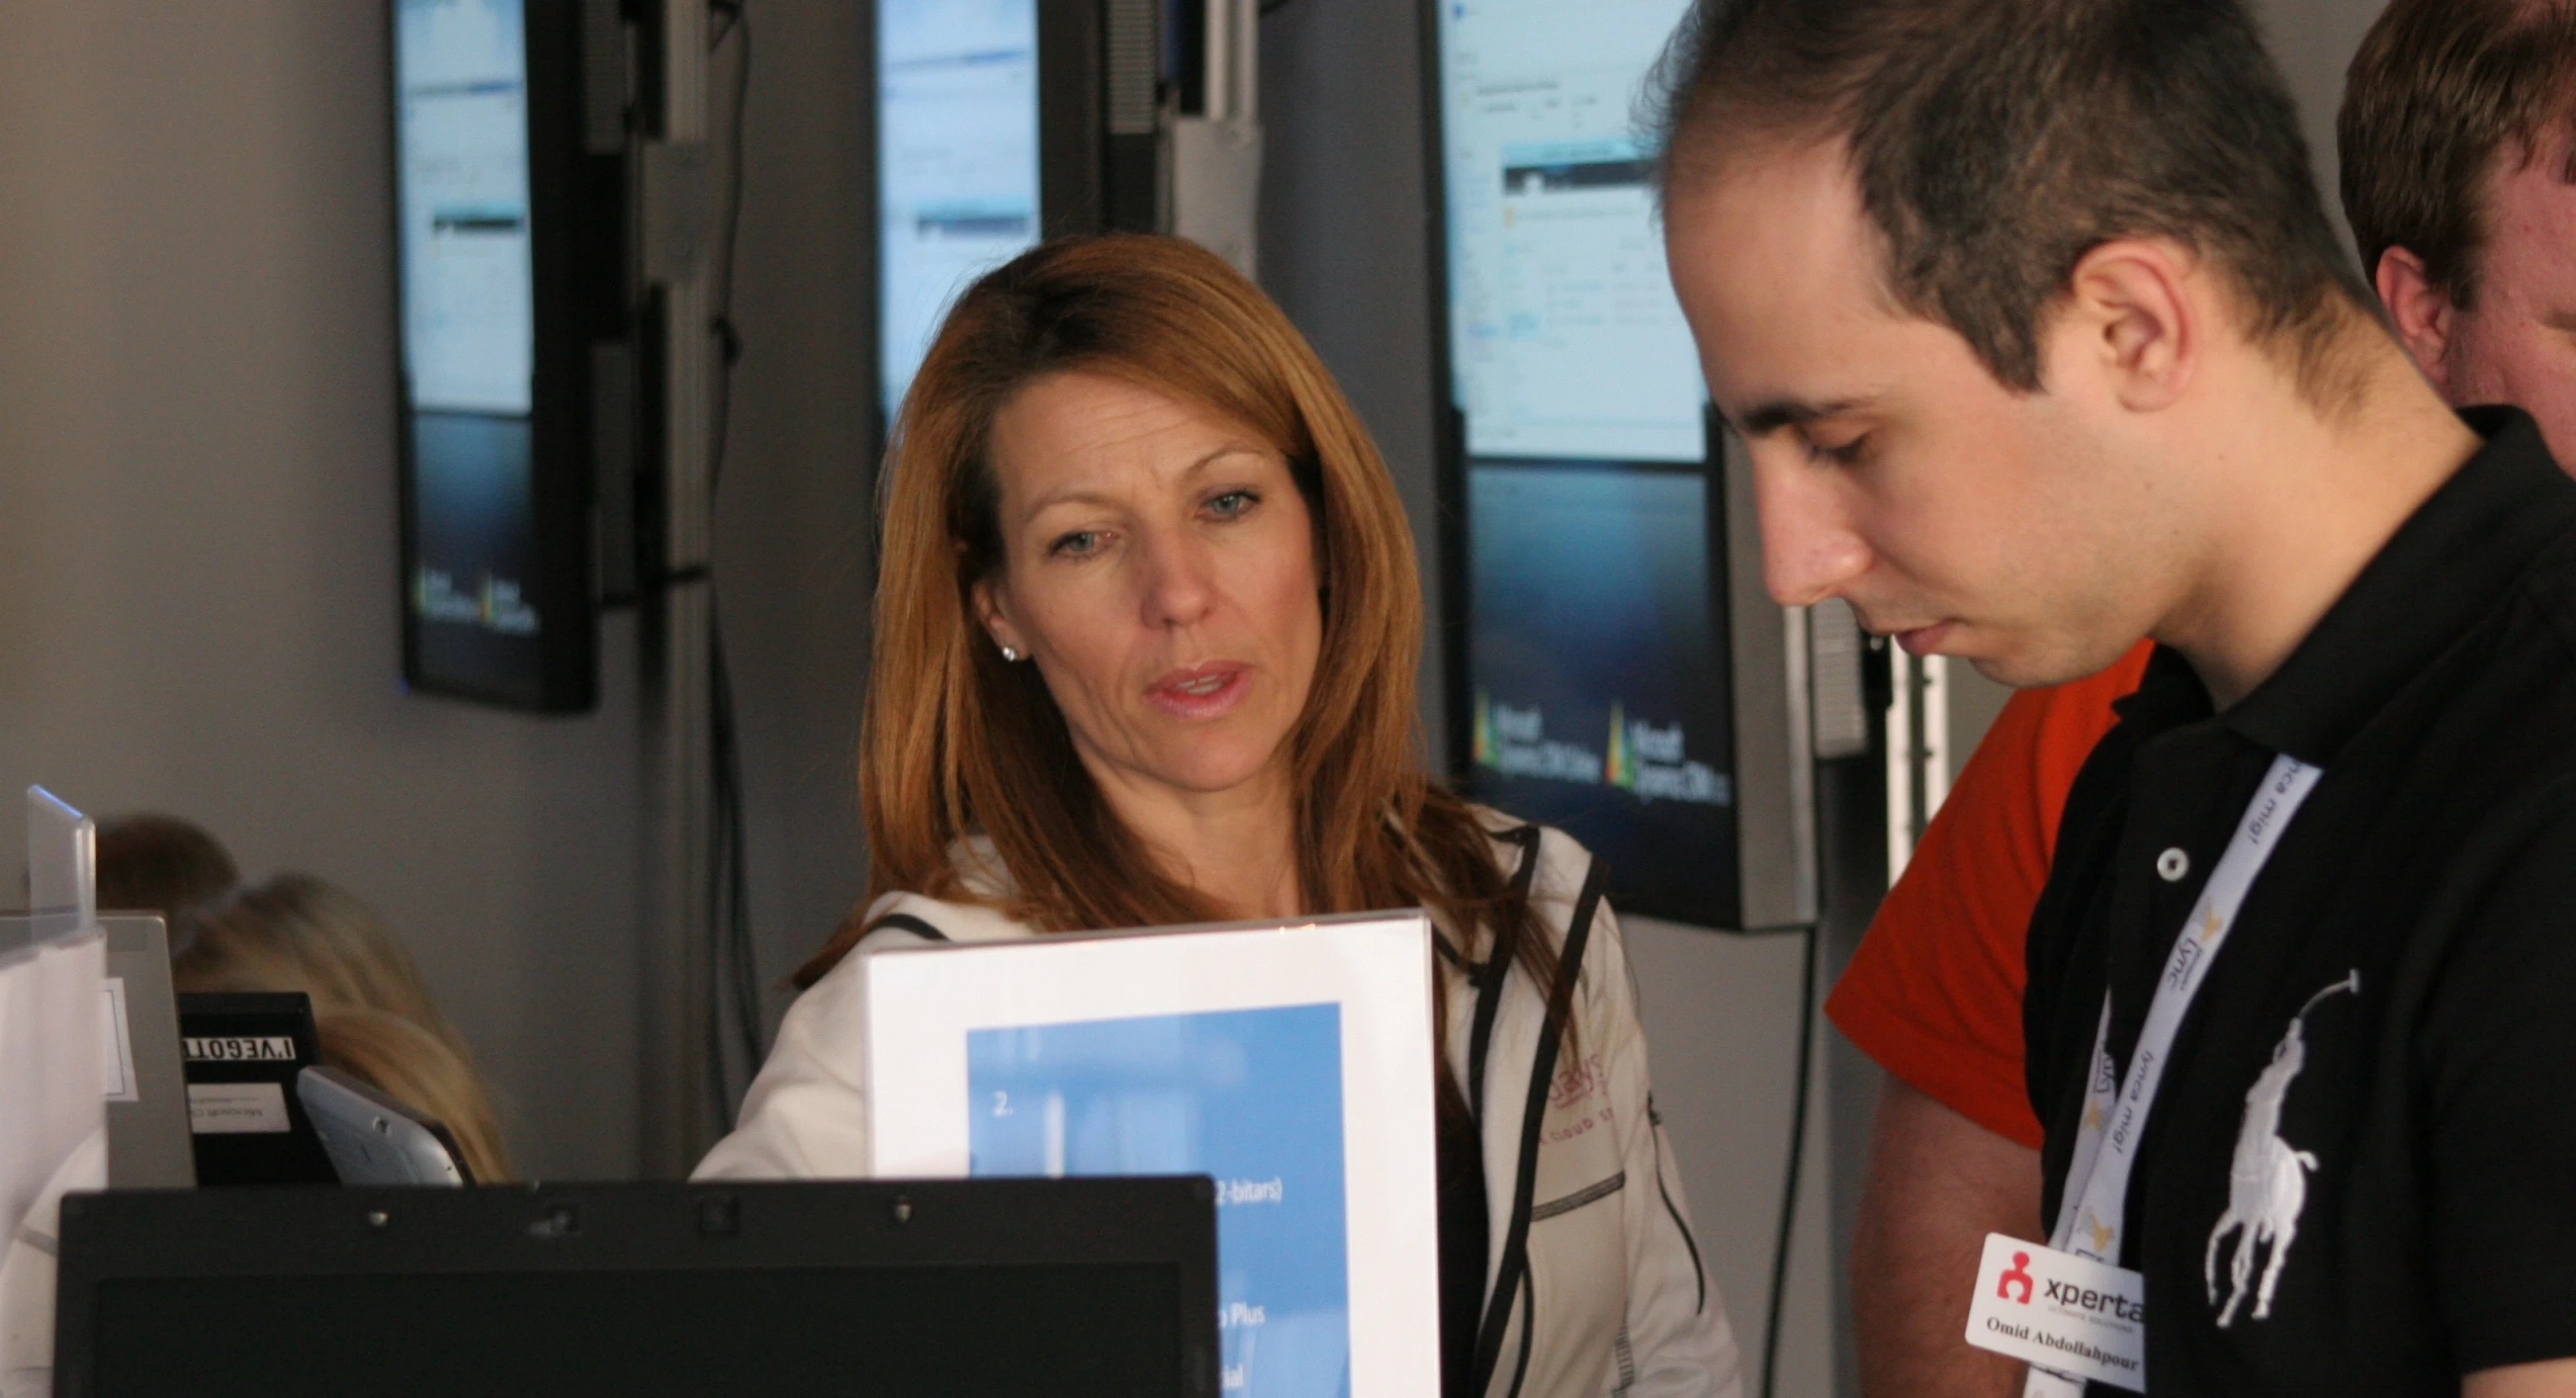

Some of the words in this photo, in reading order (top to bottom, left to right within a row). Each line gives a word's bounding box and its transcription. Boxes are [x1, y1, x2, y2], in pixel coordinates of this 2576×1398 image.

[2168, 937, 2197, 990] Lync
[2131, 1050, 2155, 1101] lynca
[994, 1091, 1014, 1116] 2.
[1230, 1302, 1266, 1326] Plus
[1987, 1316, 2029, 1340] Omid
[2032, 1331, 2141, 1371] Abdollahpour
